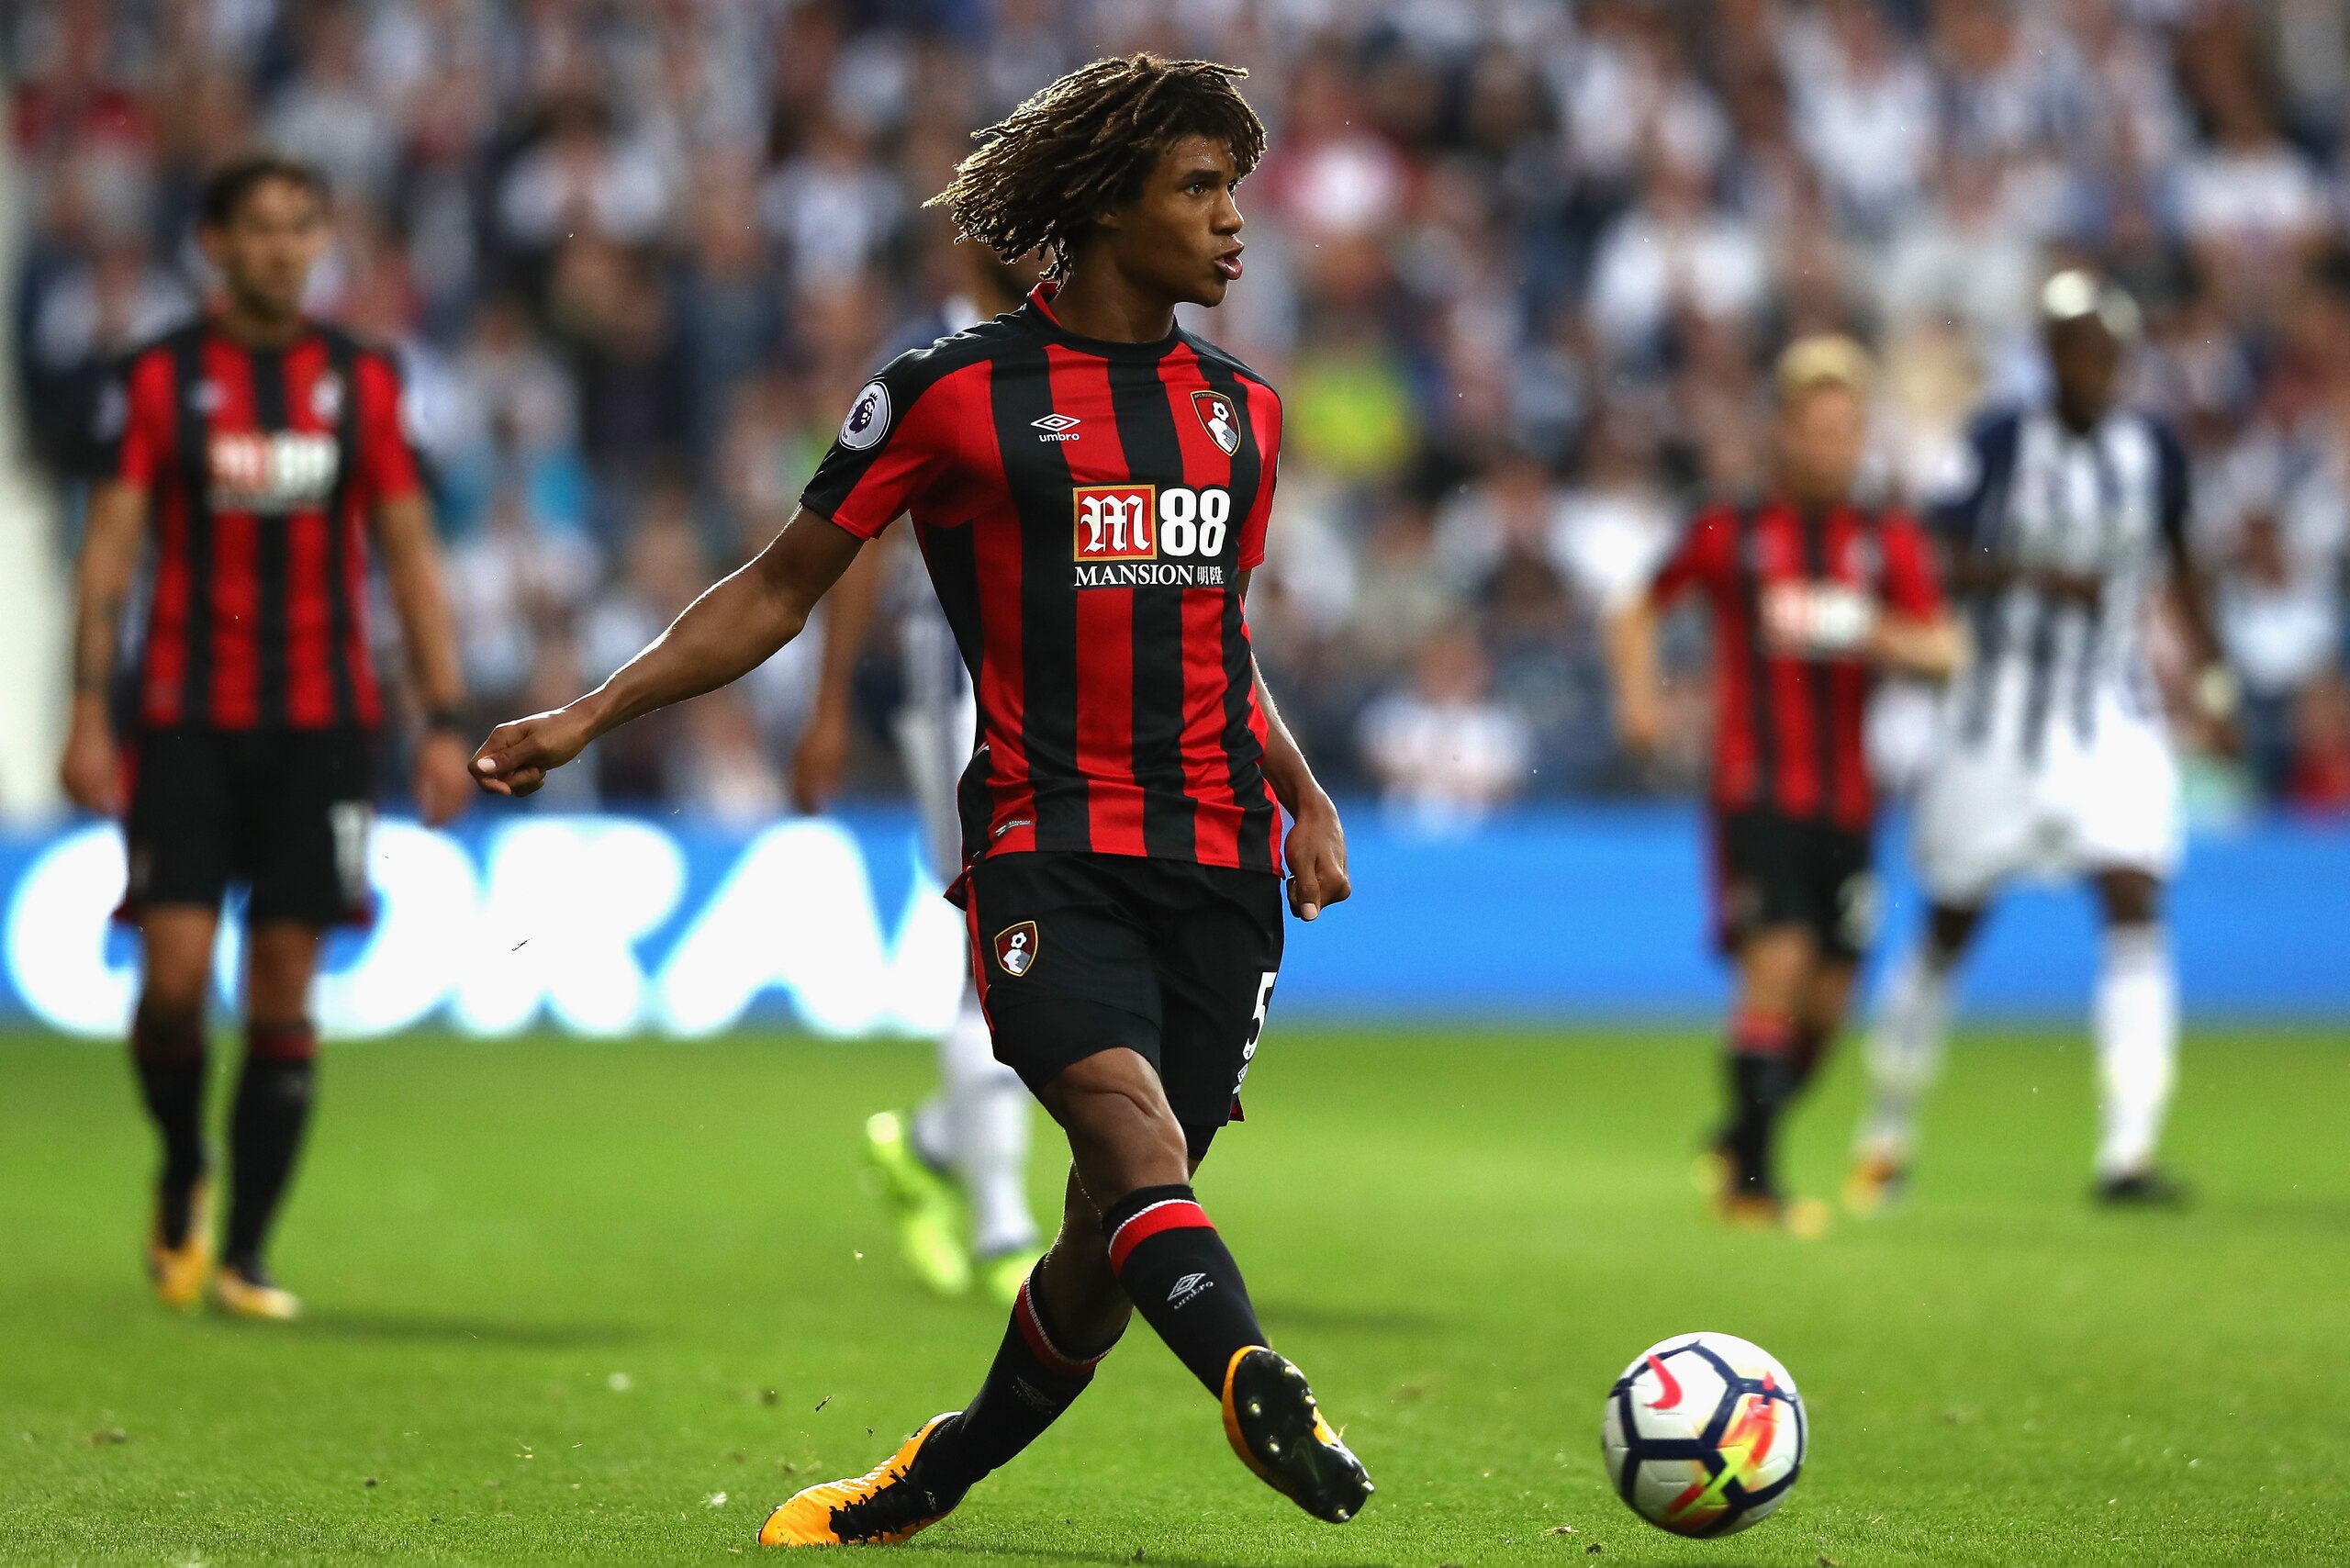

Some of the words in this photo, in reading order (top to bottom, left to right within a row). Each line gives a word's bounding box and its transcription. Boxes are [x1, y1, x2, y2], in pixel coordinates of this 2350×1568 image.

[1038, 431, 1080, 442] umbro
[1074, 564, 1194, 587] MANSION
[1242, 971, 1278, 1060] 5
